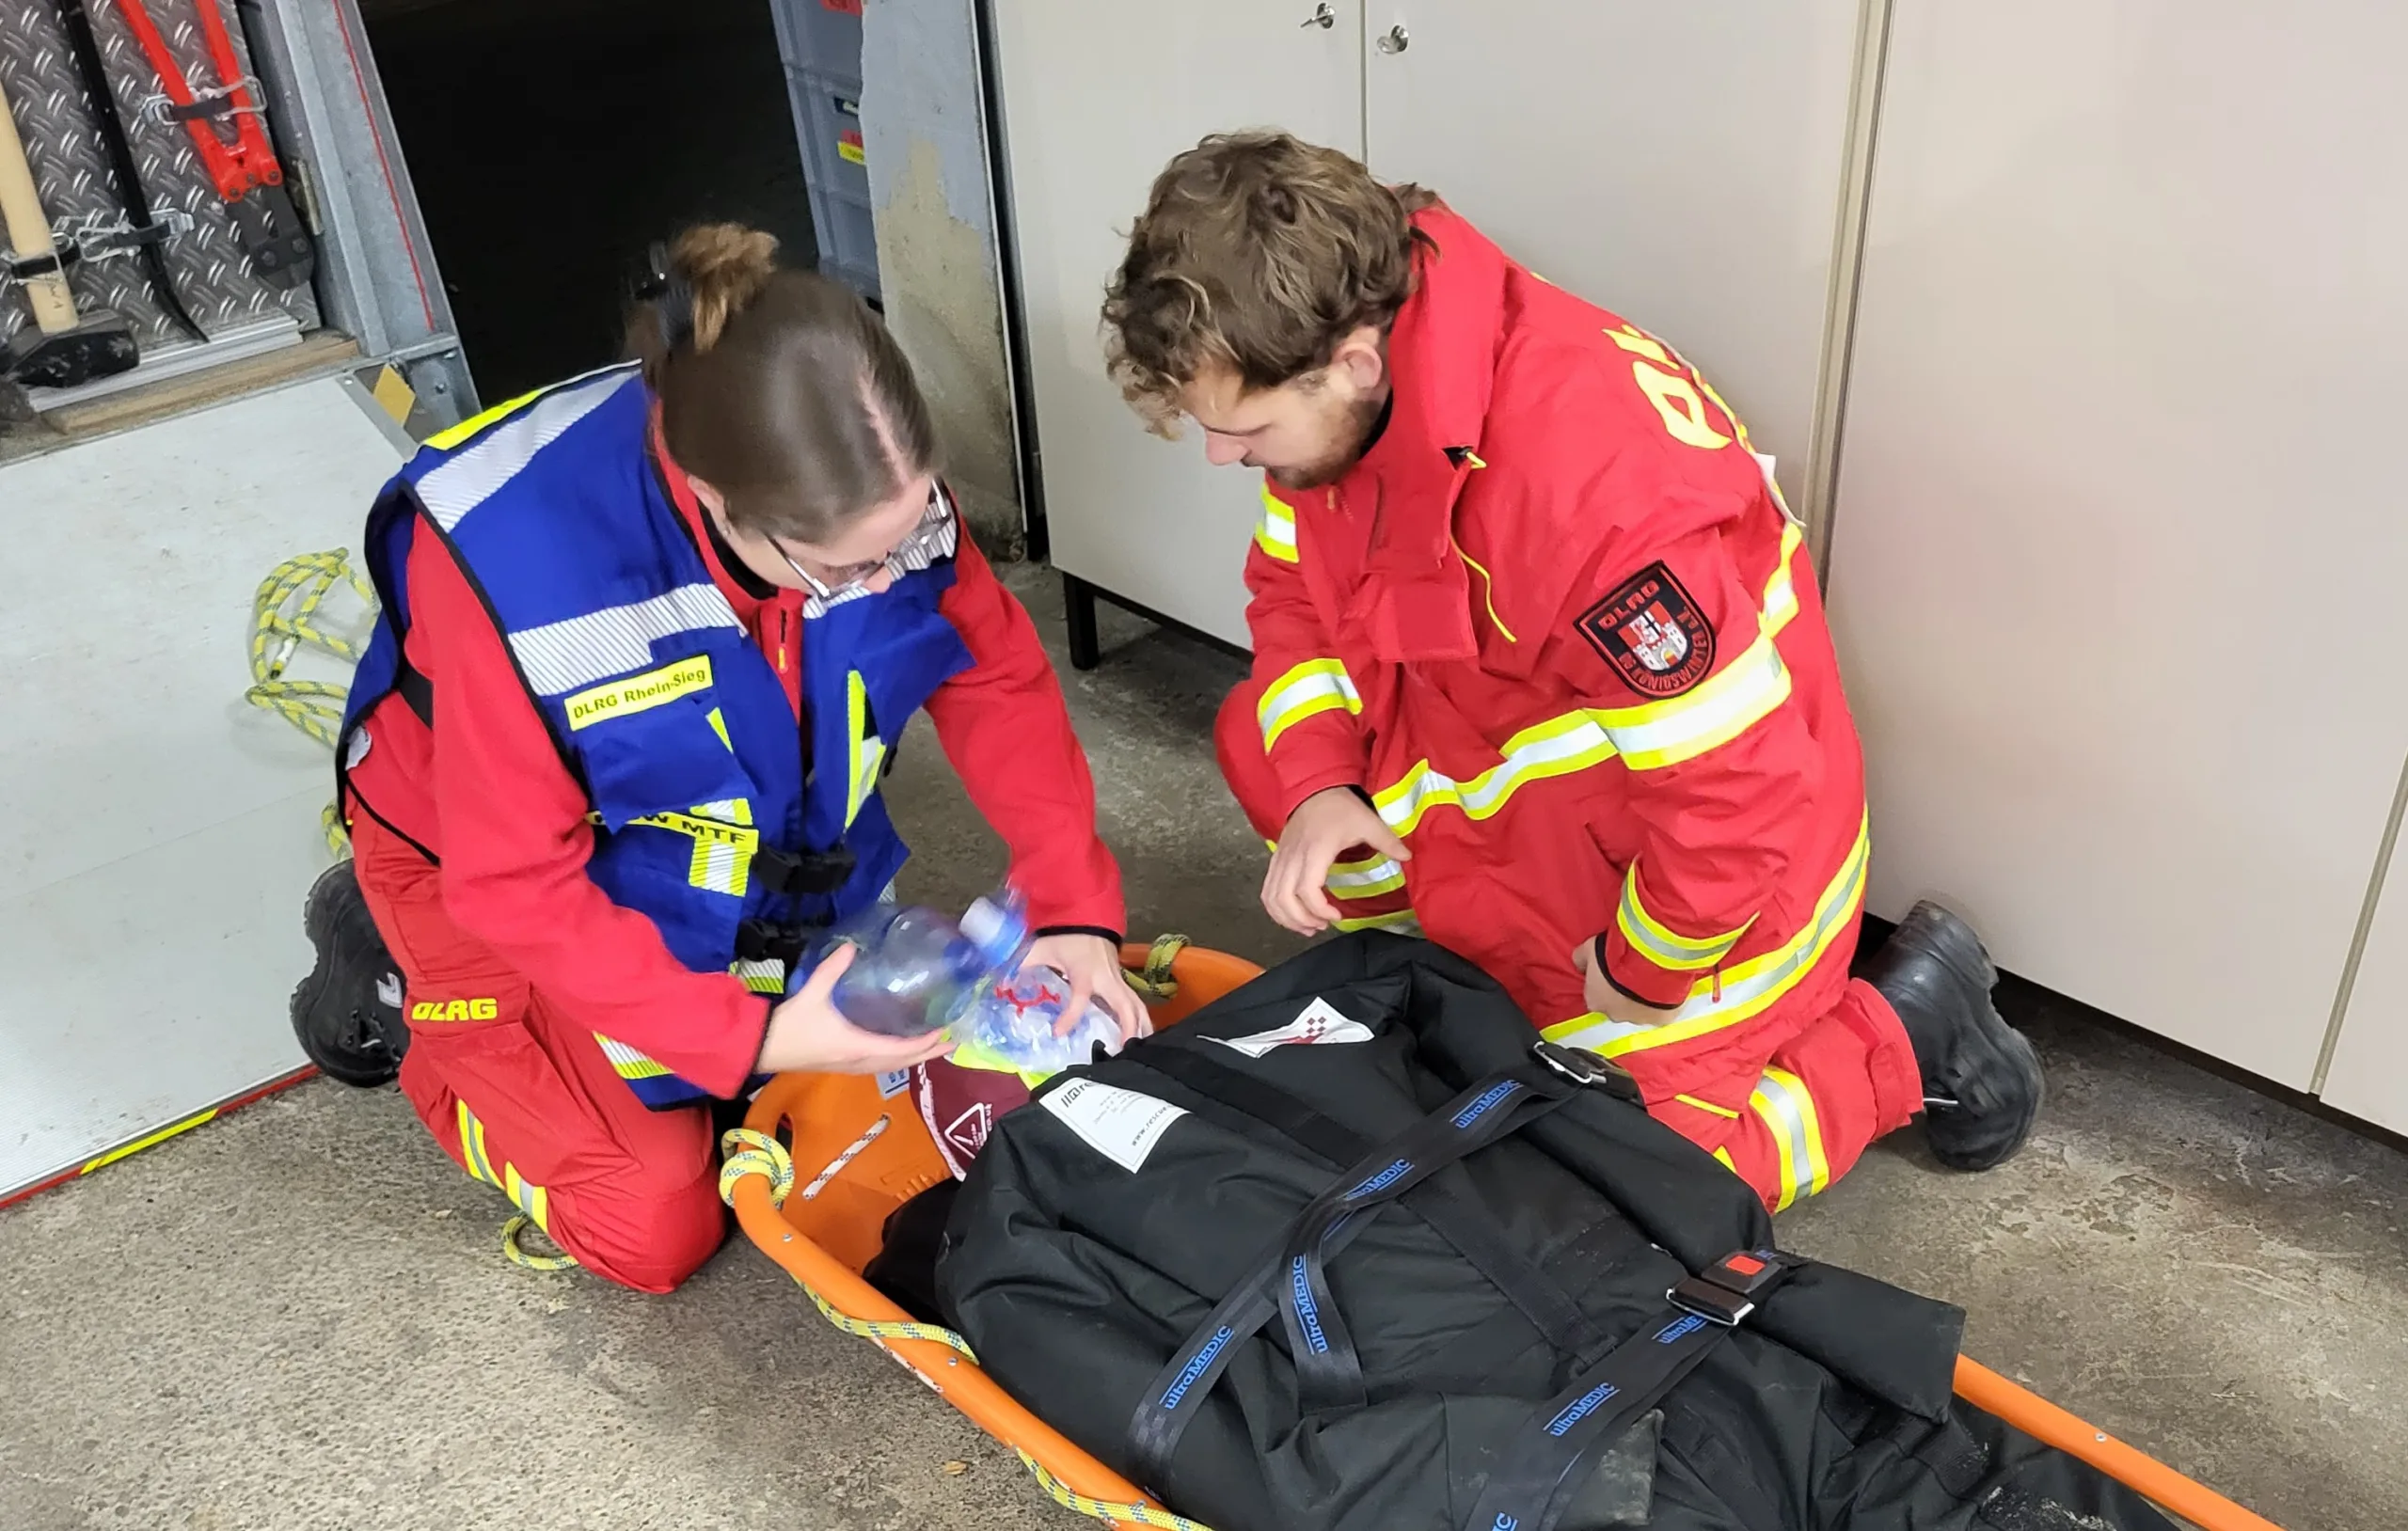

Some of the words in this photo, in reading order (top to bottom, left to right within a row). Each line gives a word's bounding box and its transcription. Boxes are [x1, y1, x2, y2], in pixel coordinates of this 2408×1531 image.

[574, 694, 618, 719] DLRG
[624, 669, 705, 702] Rhein-Sieg
[682, 821, 746, 843] MTF
[412, 998, 498, 1021] DLRG
[1455, 1080, 1521, 1129] ultraMEDIC
[1292, 1255, 1329, 1354] ultraMEDIC
[1164, 1325, 1232, 1410] ultraMEDIC
[1550, 1381, 1614, 1437] ultraMEDIC
